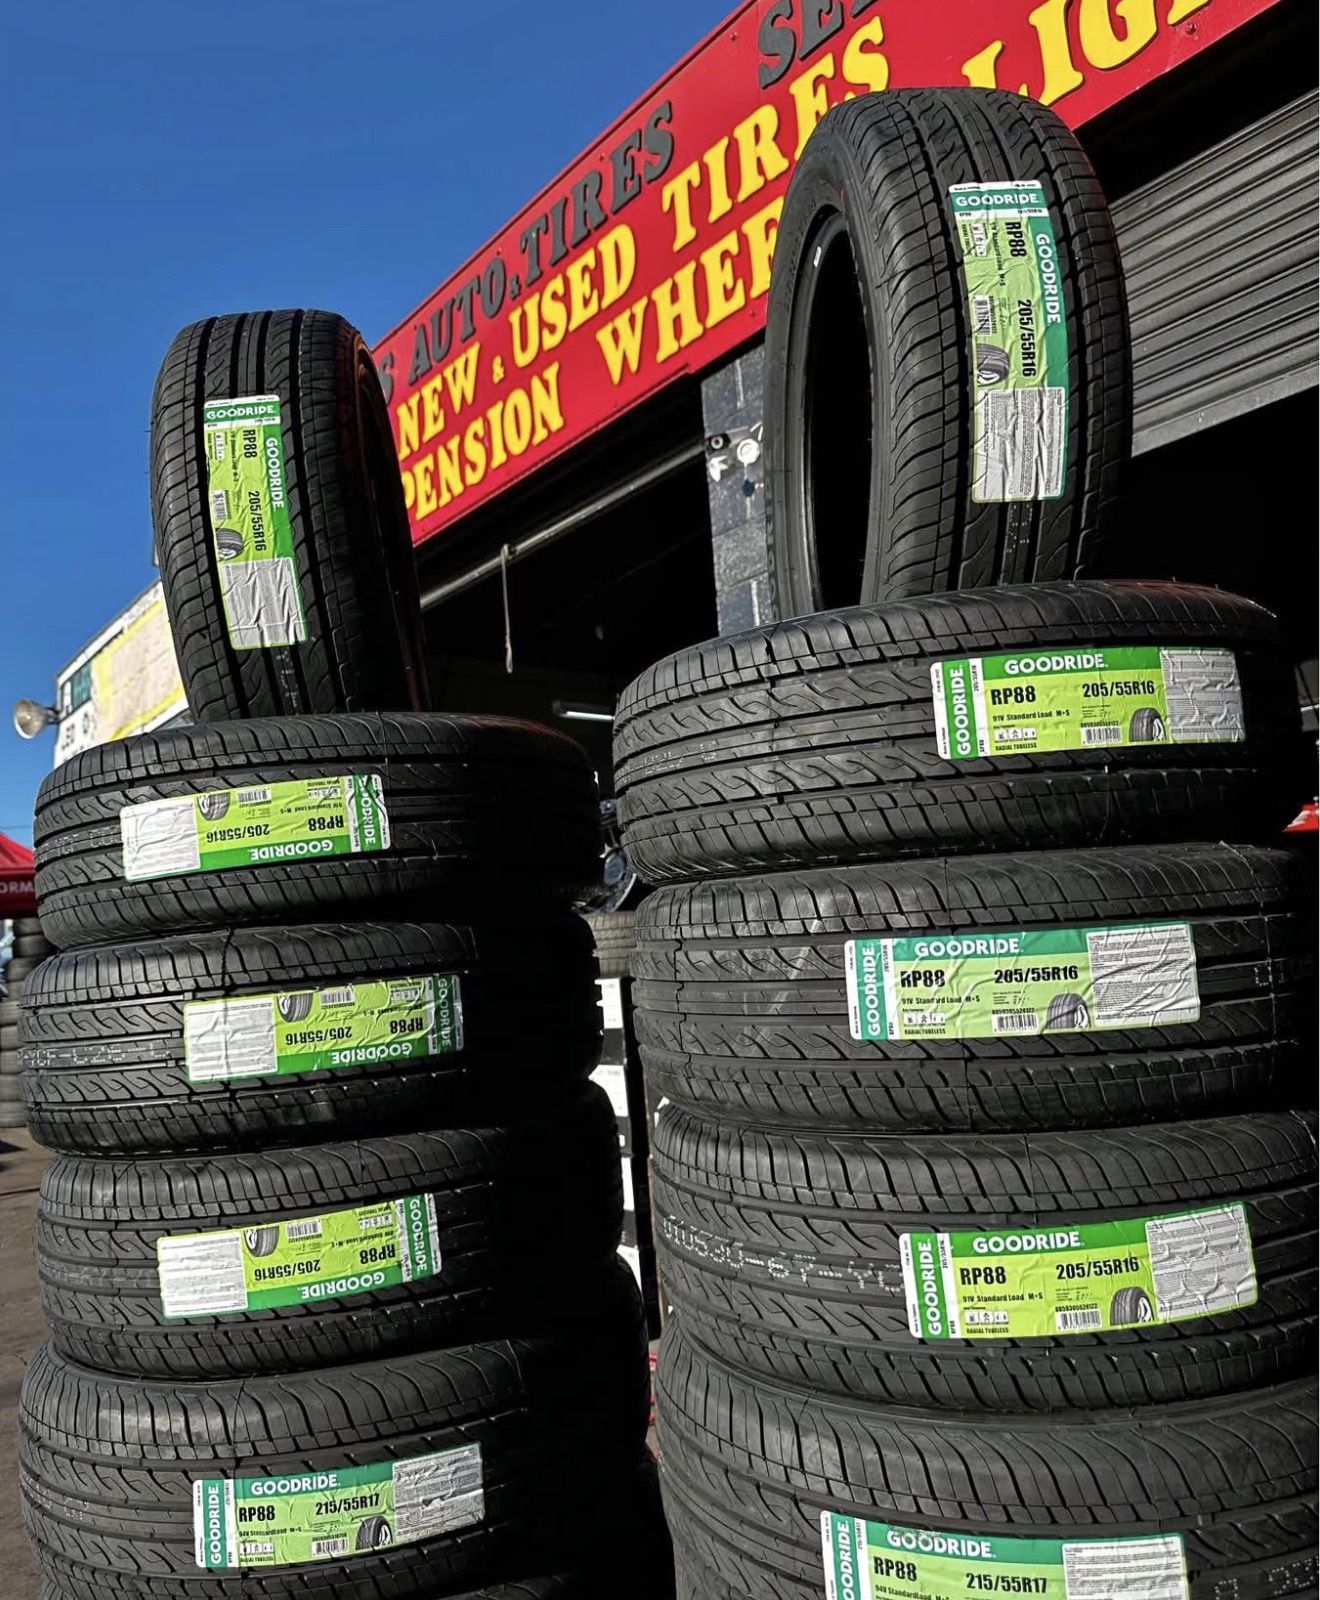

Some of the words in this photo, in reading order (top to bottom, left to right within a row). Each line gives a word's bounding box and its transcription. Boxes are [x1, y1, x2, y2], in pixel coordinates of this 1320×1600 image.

[408, 257, 506, 386] AUTO
[509, 273, 522, 300] &
[520, 100, 674, 287] TIRES
[758, 0, 880, 90] SE
[956, 193, 1039, 207] GOODRIDE
[396, 342, 480, 461] NEW
[492, 354, 505, 385] &
[508, 223, 636, 369] USED
[661, 15, 889, 253] TIRES
[1035, 233, 1061, 325] GOODRIDE
[1004, 221, 1027, 258] RP88
[1017, 299, 1037, 378] 205/55R16
[206, 405, 275, 420] GOODRIDE
[242, 429, 258, 459] RP88
[265, 437, 285, 509] GOODRIDE
[248, 490, 267, 552] 205/55R16
[1004, 653, 1106, 675] GOODRIDE
[990, 685, 1037, 706] RP88
[1082, 680, 1155, 698] 205/55R16
[949, 666, 971, 756] GOODRIDE
[1006, 712, 1037, 721] Standard
[1037, 711, 1053, 719] Load
[206, 823, 271, 843] 205/55R16
[307, 815, 344, 832] RP88
[251, 839, 333, 861] GOODRIDE
[914, 937, 1021, 958] GOODRIDE
[900, 969, 946, 988] RP88
[994, 965, 1079, 984] 205/55R16
[862, 945, 881, 1036] GOODRIDE
[389, 1017, 424, 1034] RP88
[438, 978, 452, 1047] GOODRIDE
[285, 1026, 352, 1045] 205/55R16
[331, 1042, 413, 1064] GOODRIDE
[410, 1199, 428, 1272] GOODRIDE
[972, 1231, 1082, 1254] GOODRIDE
[359, 1243, 396, 1265] RP88
[254, 1259, 320, 1282] 205/55R16
[960, 1266, 1007, 1286] RP88
[1055, 1256, 1139, 1280] 205/55R16
[301, 1271, 385, 1299] GOODRIDE
[918, 1240, 942, 1336] GOODRIDE
[977, 1294, 1007, 1302] Standard
[1008, 1293, 1024, 1301] Load
[251, 1474, 339, 1496] GOODRIDE
[238, 1505, 276, 1523] RP88
[315, 1493, 380, 1516] 215/55R17
[208, 1484, 222, 1564] GOODRIDE
[886, 1530, 994, 1558] GOODRIDE
[873, 1556, 917, 1582] RP88
[965, 1571, 1047, 1594] 215/55R17
